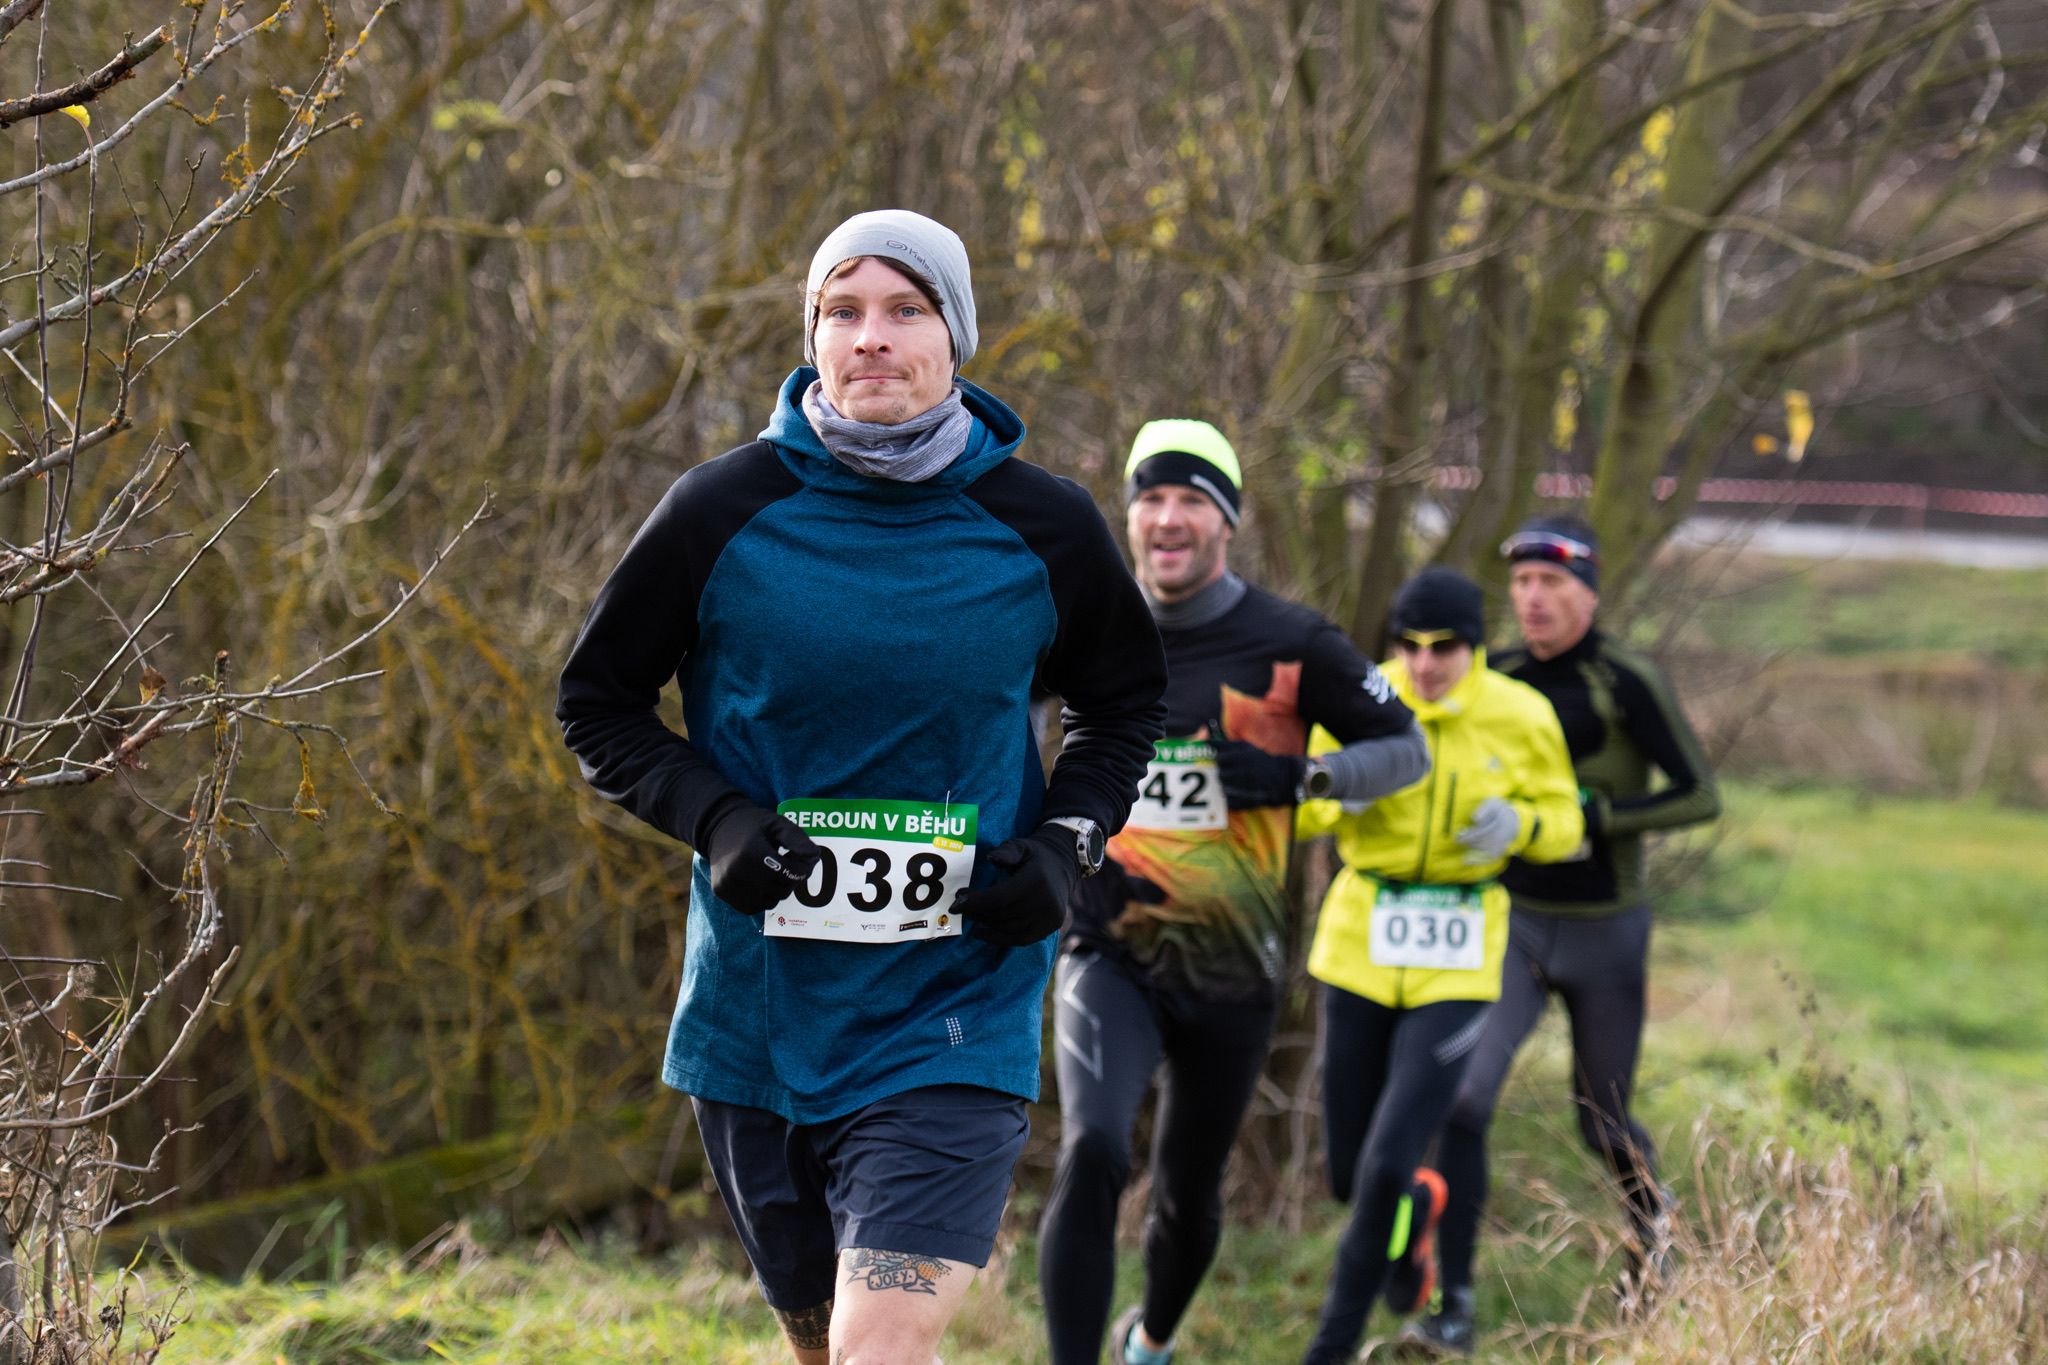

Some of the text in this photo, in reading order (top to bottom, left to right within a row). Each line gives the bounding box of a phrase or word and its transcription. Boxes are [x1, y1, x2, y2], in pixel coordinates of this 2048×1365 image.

[783, 810, 966, 836] BEROUN V BĚHU
[793, 845, 948, 912] 038
[1386, 915, 1467, 948] 030
[876, 1271, 909, 1288] JOEY
